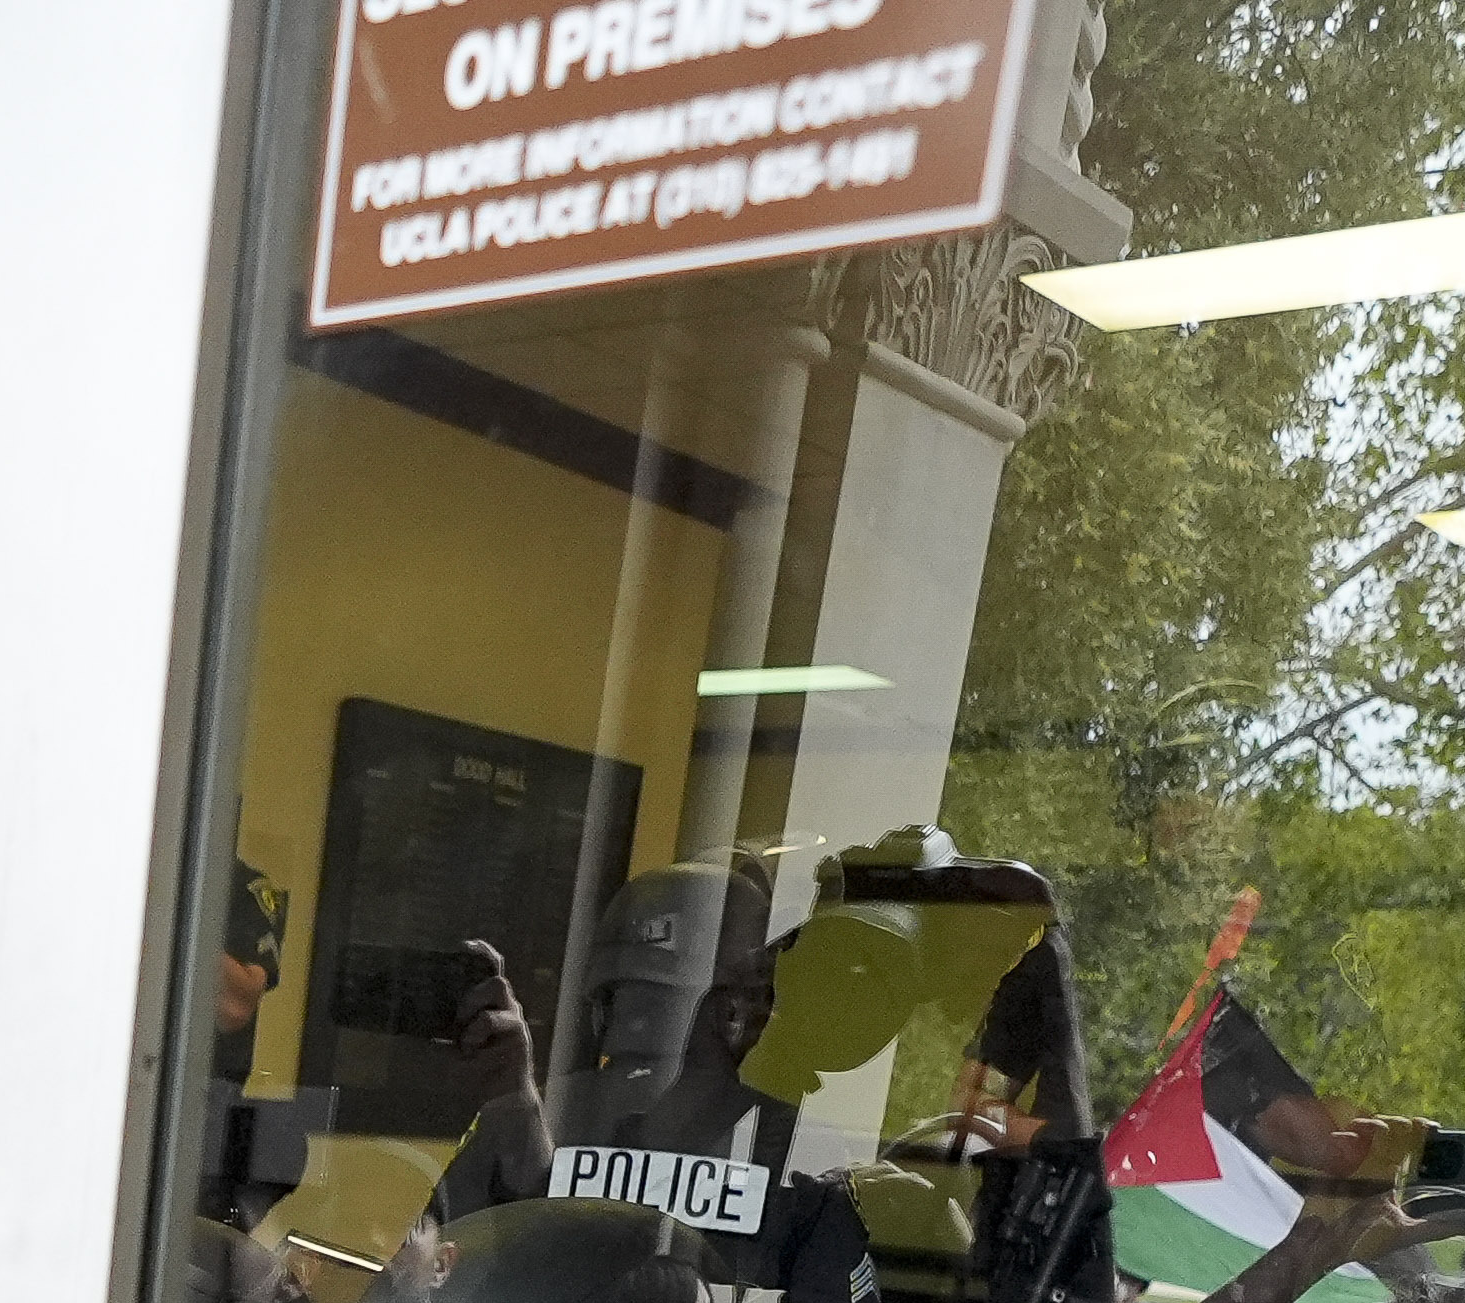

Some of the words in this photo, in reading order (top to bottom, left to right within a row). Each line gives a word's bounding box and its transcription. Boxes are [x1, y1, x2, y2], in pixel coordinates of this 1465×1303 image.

[443, 15, 543, 111] ON
[351, 152, 423, 213] FOR
[422, 132, 524, 200] MORE
[524, 82, 780, 181] INFORMATION
[779, 39, 986, 134] CONTACT
[380, 206, 471, 267] UCLA
[471, 179, 604, 251] POLICE
[600, 170, 658, 229] AT
[569, 1149, 750, 1222] POLICE
